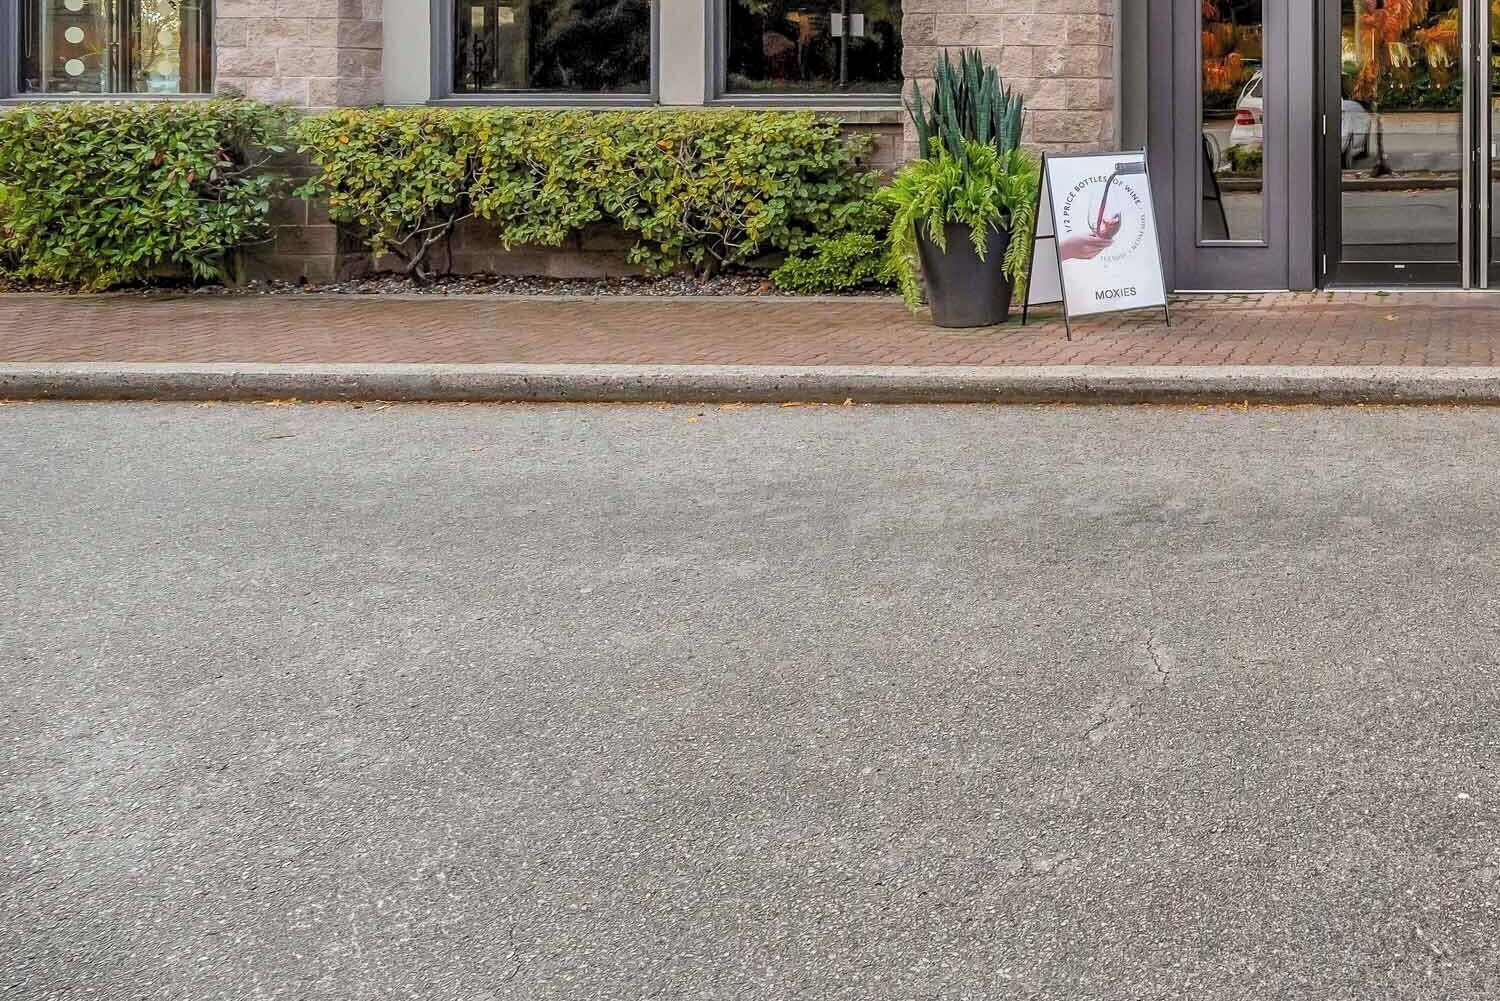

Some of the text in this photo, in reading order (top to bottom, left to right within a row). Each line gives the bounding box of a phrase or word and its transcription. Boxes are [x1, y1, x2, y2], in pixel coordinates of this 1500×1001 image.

[1063, 192, 1076, 216] PRICE
[1073, 175, 1107, 193] BOTTLES
[1124, 185, 1142, 206] WINE
[1095, 286, 1137, 301] MOXIES
